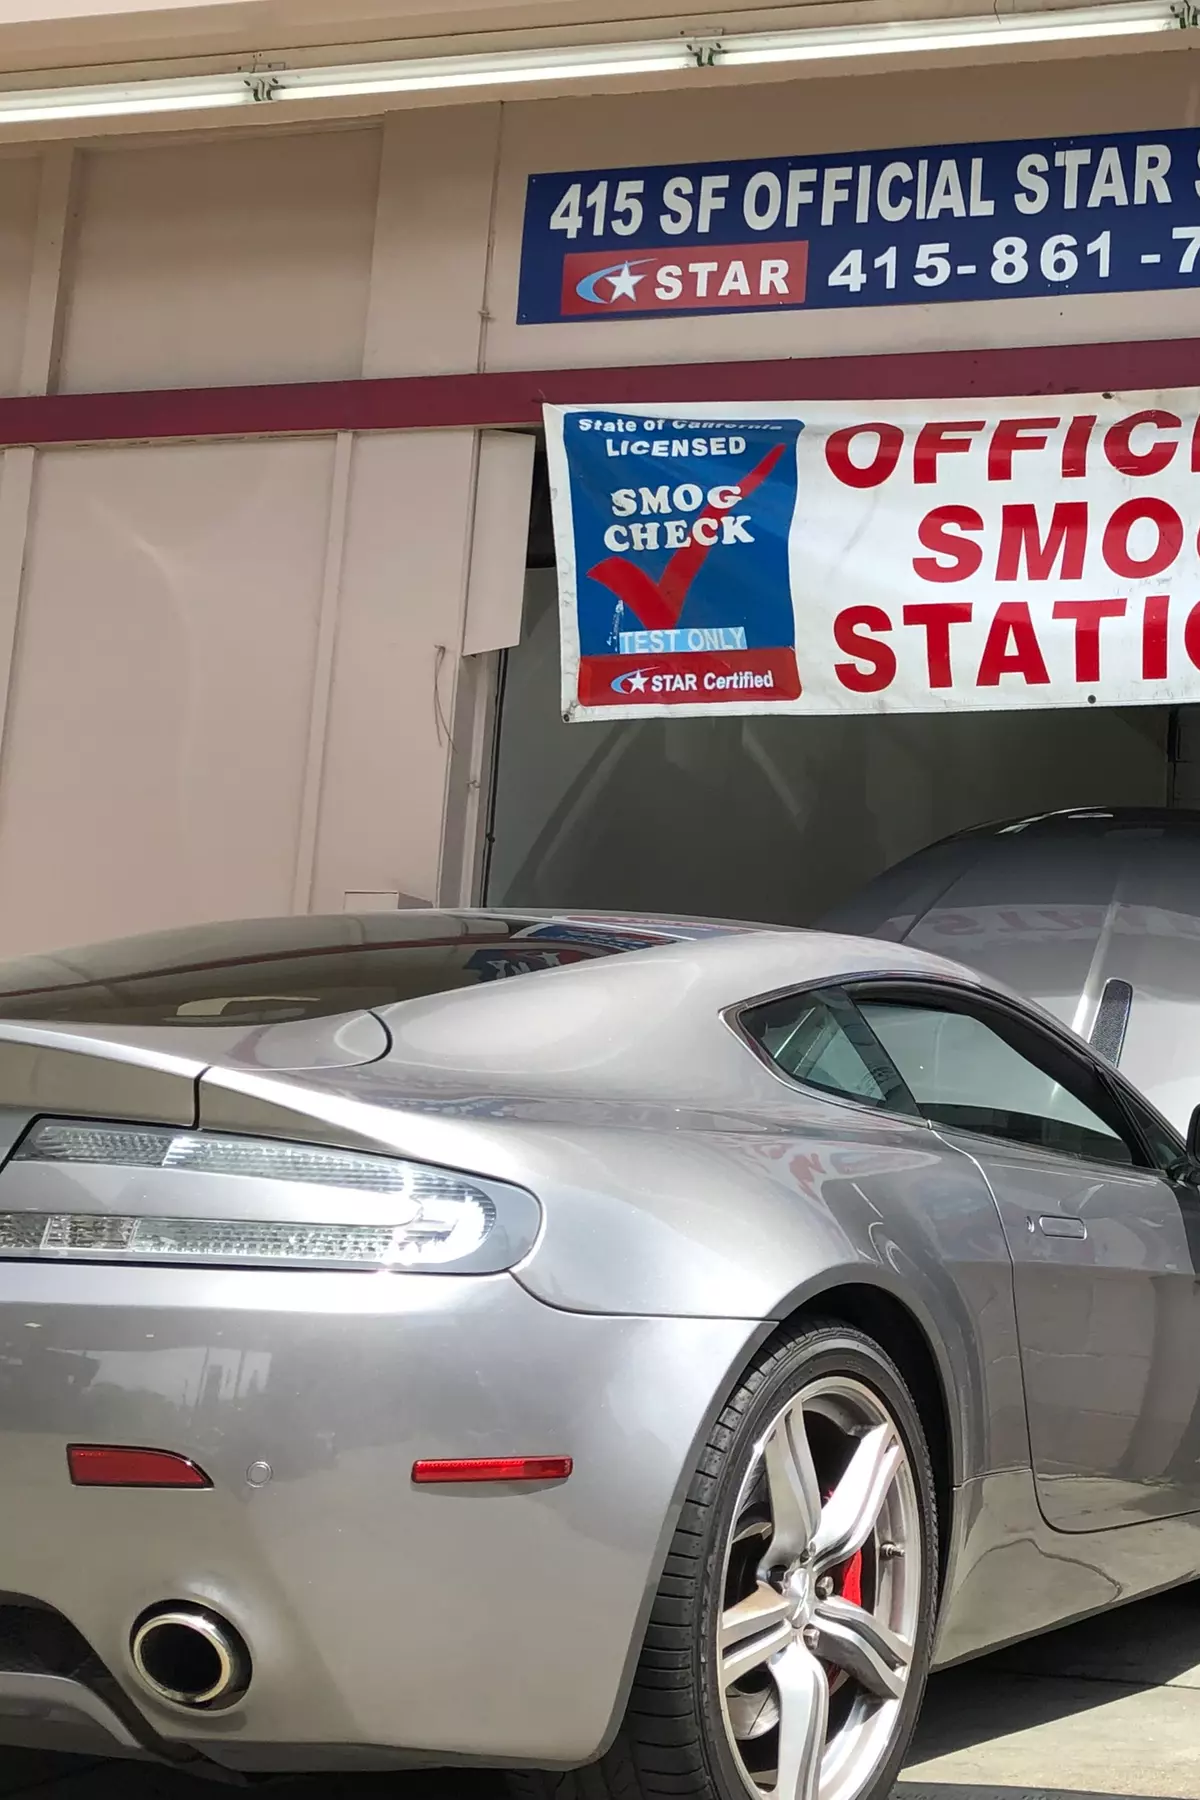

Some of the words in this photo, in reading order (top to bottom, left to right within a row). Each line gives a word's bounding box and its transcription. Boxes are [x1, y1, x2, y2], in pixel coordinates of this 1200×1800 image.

[550, 180, 644, 239] 415
[660, 175, 729, 235] SF
[743, 157, 994, 230] OFFICIAL
[1014, 144, 1173, 214] STAR
[655, 259, 789, 301] STAR
[579, 418, 636, 432] State
[644, 418, 664, 431] of
[606, 436, 746, 457] LICENSED
[611, 484, 743, 517] SMOG
[604, 515, 755, 552] CHECK
[620, 630, 680, 653] TEST
[687, 628, 744, 650] ONLY
[651, 675, 697, 692] STAR
[703, 671, 774, 690] Certified
